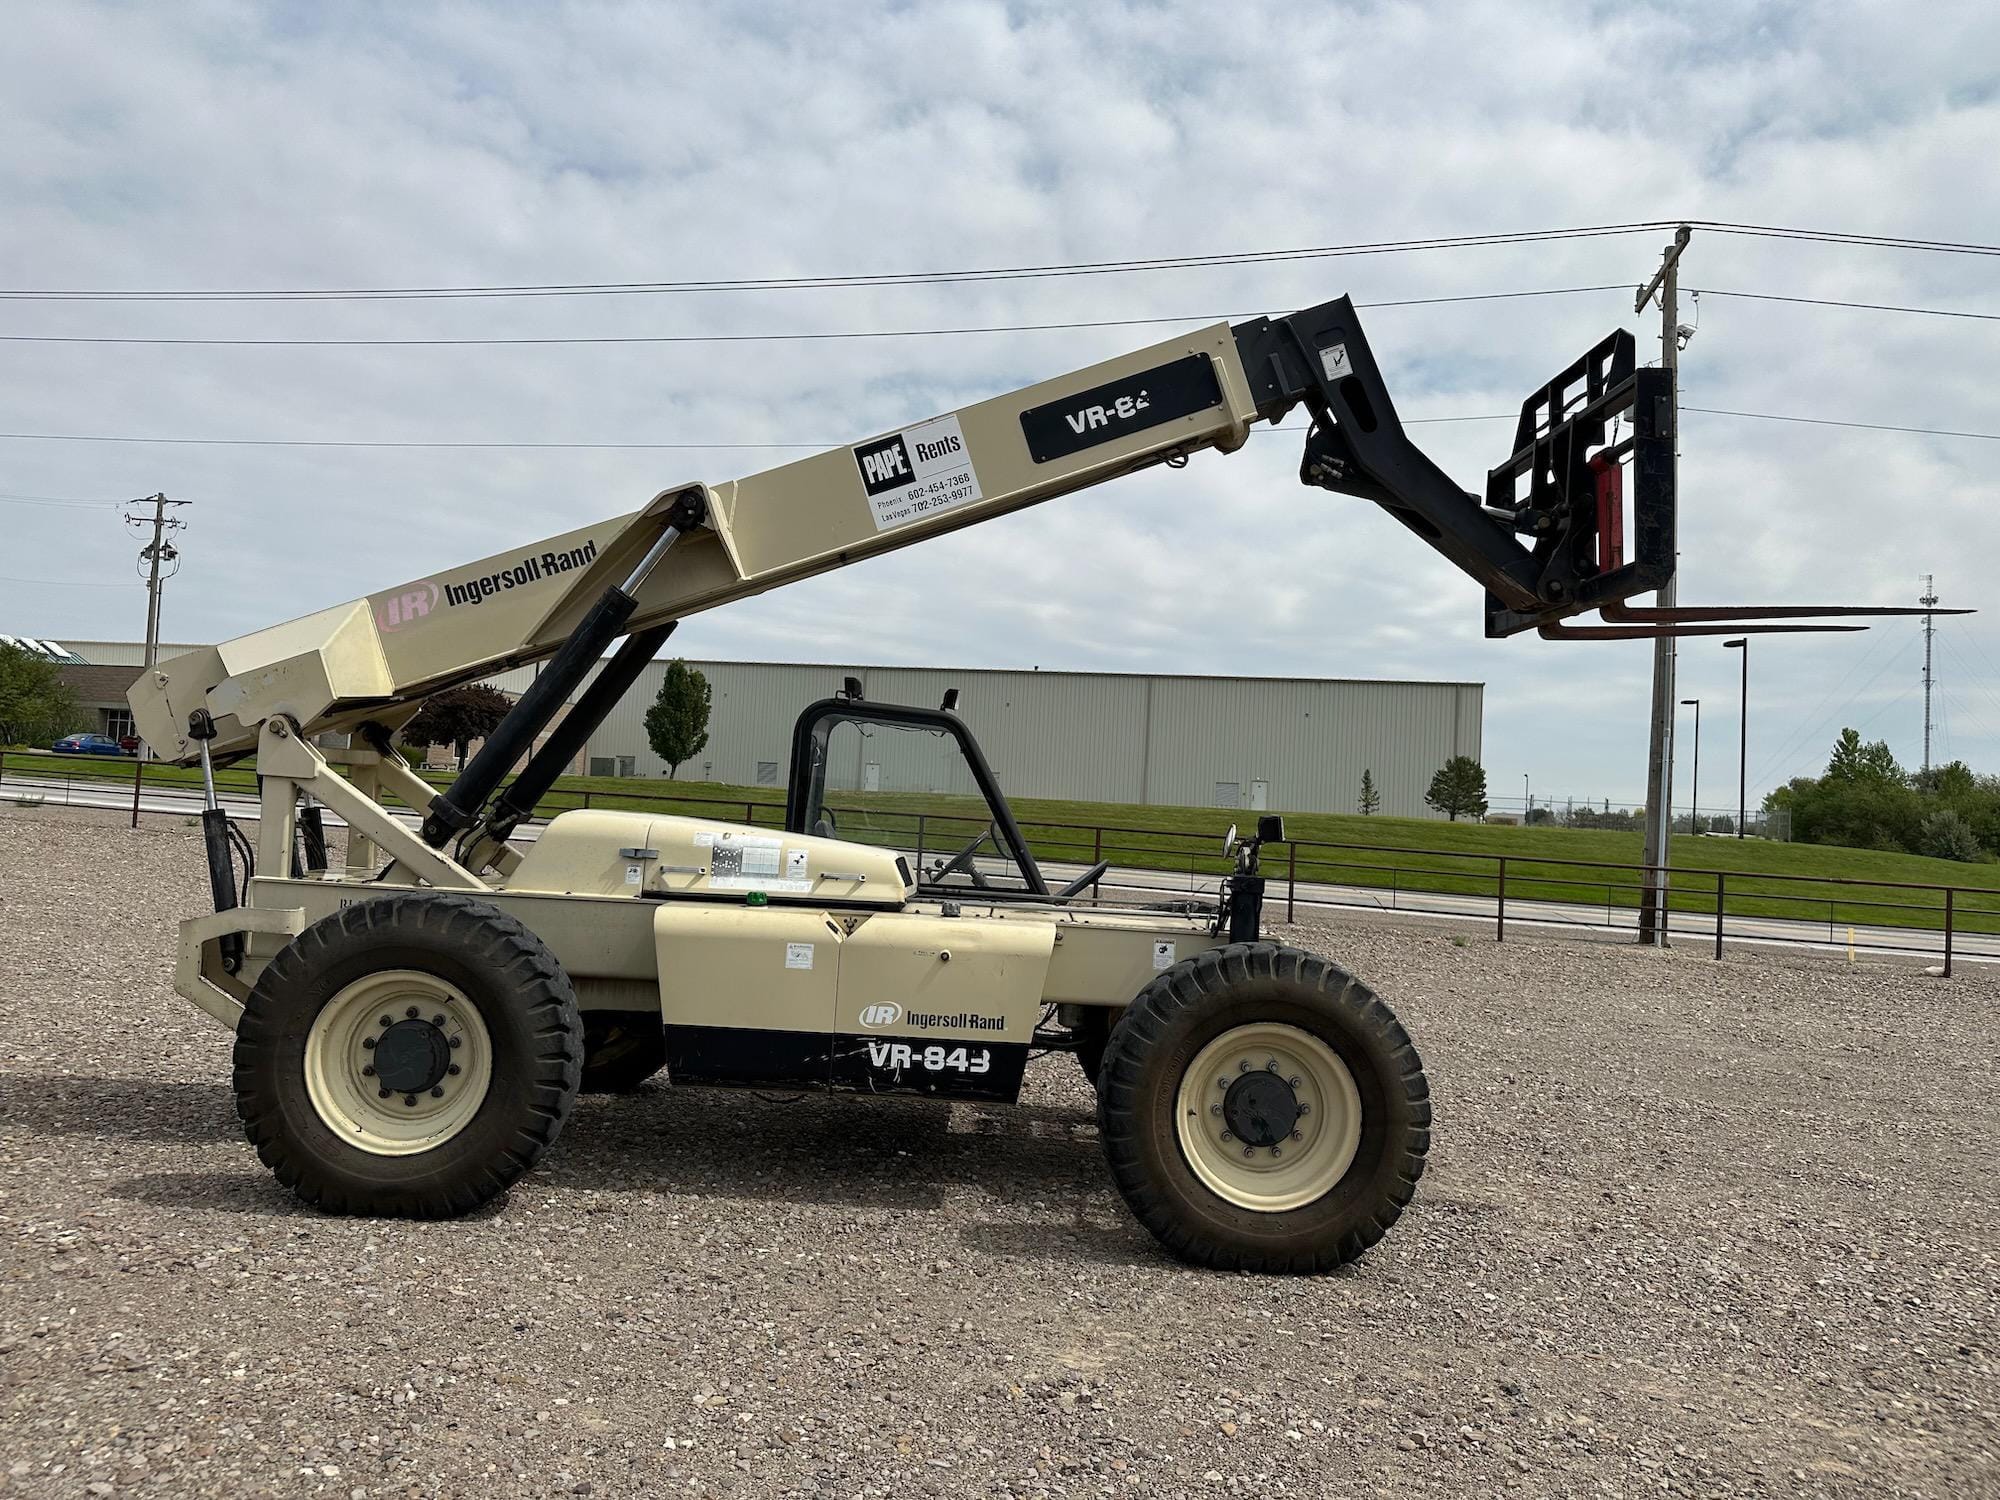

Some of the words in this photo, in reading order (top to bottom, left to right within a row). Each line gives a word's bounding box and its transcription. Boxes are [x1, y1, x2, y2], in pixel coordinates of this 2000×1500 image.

[915, 435, 961, 462] Rents
[877, 496, 903, 510] Phoenix
[907, 472, 970, 501] 602-454-7368
[911, 485, 973, 513] 702-253-9977
[866, 1005, 896, 1025] IR
[907, 1010, 1005, 1031] Ingersoll-Rand
[868, 1042, 991, 1073] VR-843
